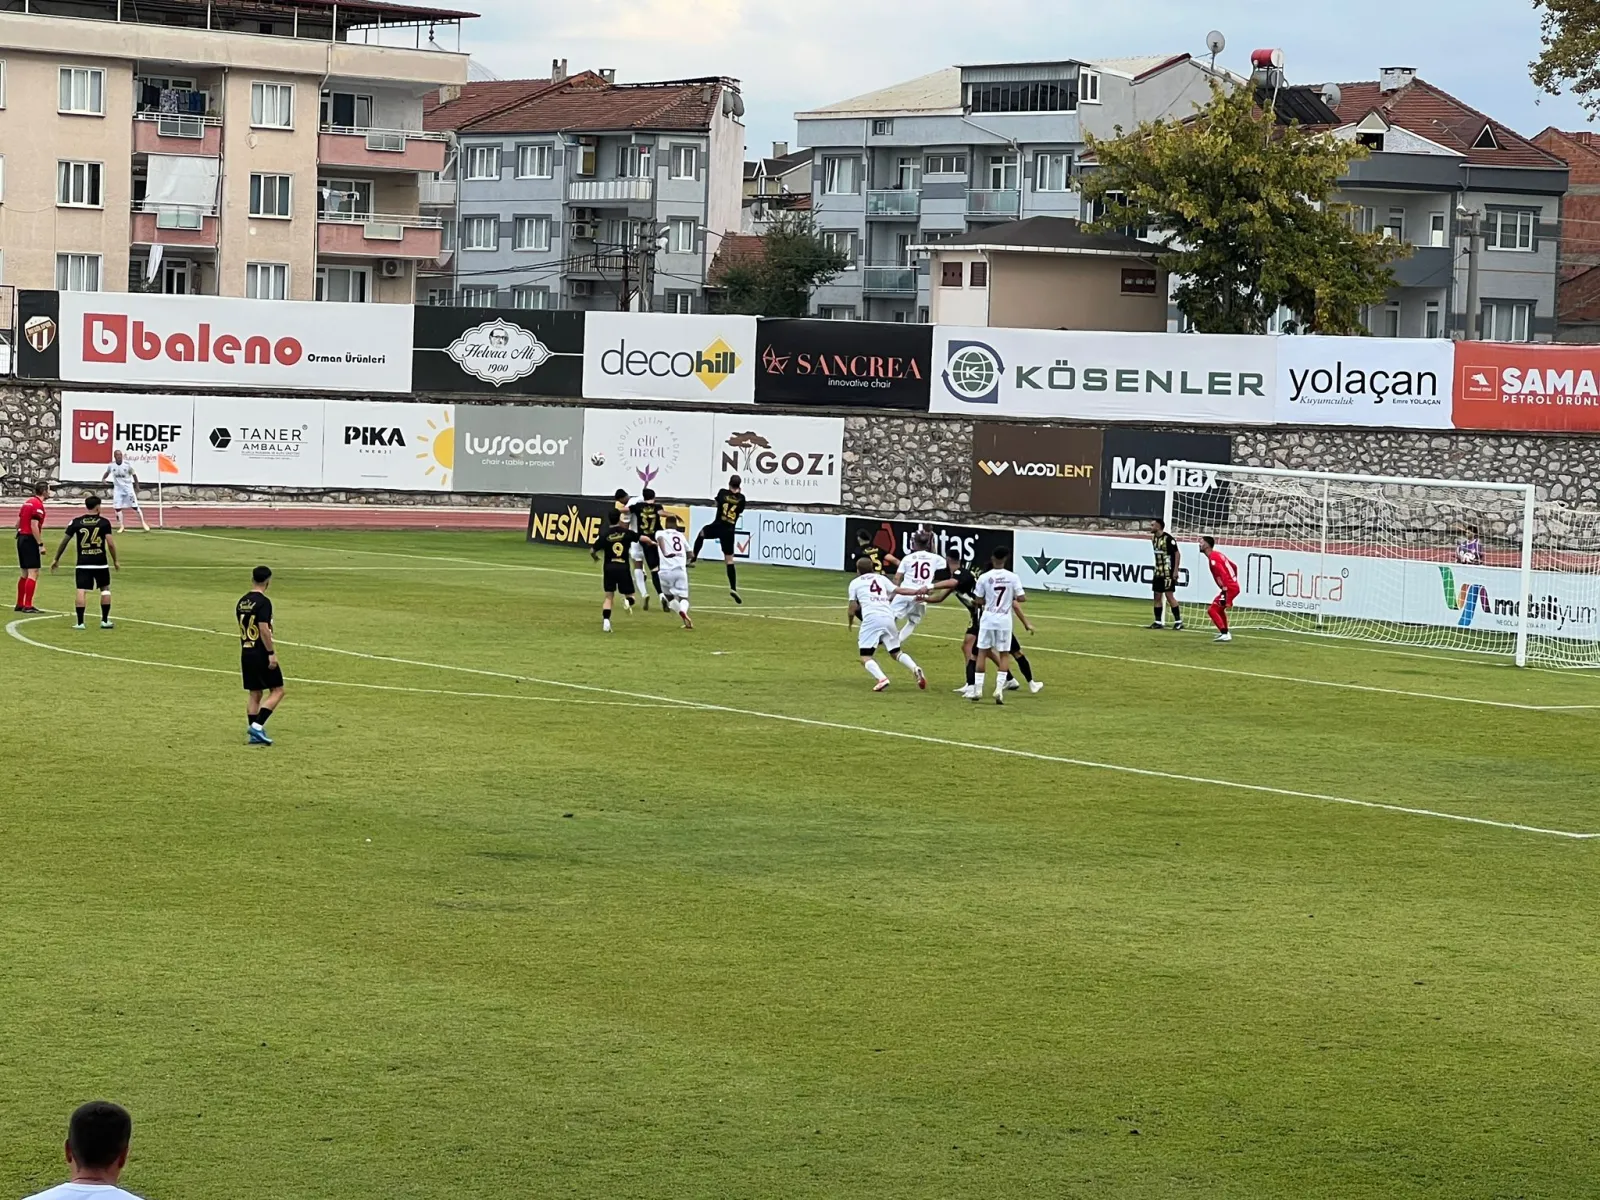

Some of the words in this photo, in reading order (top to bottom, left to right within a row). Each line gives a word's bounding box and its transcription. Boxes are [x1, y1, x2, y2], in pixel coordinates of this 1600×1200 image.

[132, 321, 302, 366] baleno
[307, 353, 342, 363] Orman
[345, 352, 386, 364] Ürünleri
[510, 345, 536, 360] Ali
[601, 338, 736, 377] decohill
[487, 363, 509, 373] 1900
[796, 353, 922, 379] SANCREA
[827, 377, 869, 388] innovative
[870, 378, 891, 388] chair
[1016, 359, 1266, 396] KÖSENLER
[1288, 361, 1437, 404] yolaçan
[1501, 367, 1600, 396] SAMA
[1299, 396, 1355, 406] Kuyumculuk
[1410, 398, 1441, 406] YOLAÇAN
[1502, 395, 1552, 405] PETROL
[116, 423, 182, 442] HEDEF
[240, 427, 302, 441] TANER
[126, 442, 168, 454] AHŞAP
[242, 443, 300, 452] AMBALAJ
[465, 432, 569, 455] lussodor
[481, 458, 501, 466] chair
[504, 459, 525, 467] table
[528, 459, 555, 469] project
[1012, 460, 1094, 478] WOODLENT
[743, 477, 768, 487] HŞAP
[772, 477, 780, 486] &
[784, 478, 819, 487] BERJER
[762, 517, 813, 536] markan
[80, 527, 103, 548] 24
[672, 536, 682, 552] 8
[611, 542, 624, 557] 9
[761, 543, 817, 566] ambalaj
[911, 561, 931, 580] 16
[1064, 559, 1190, 587] STARWOD
[869, 579, 882, 596] 4
[993, 586, 1007, 607] 7
[1275, 599, 1321, 610] aksesuar
